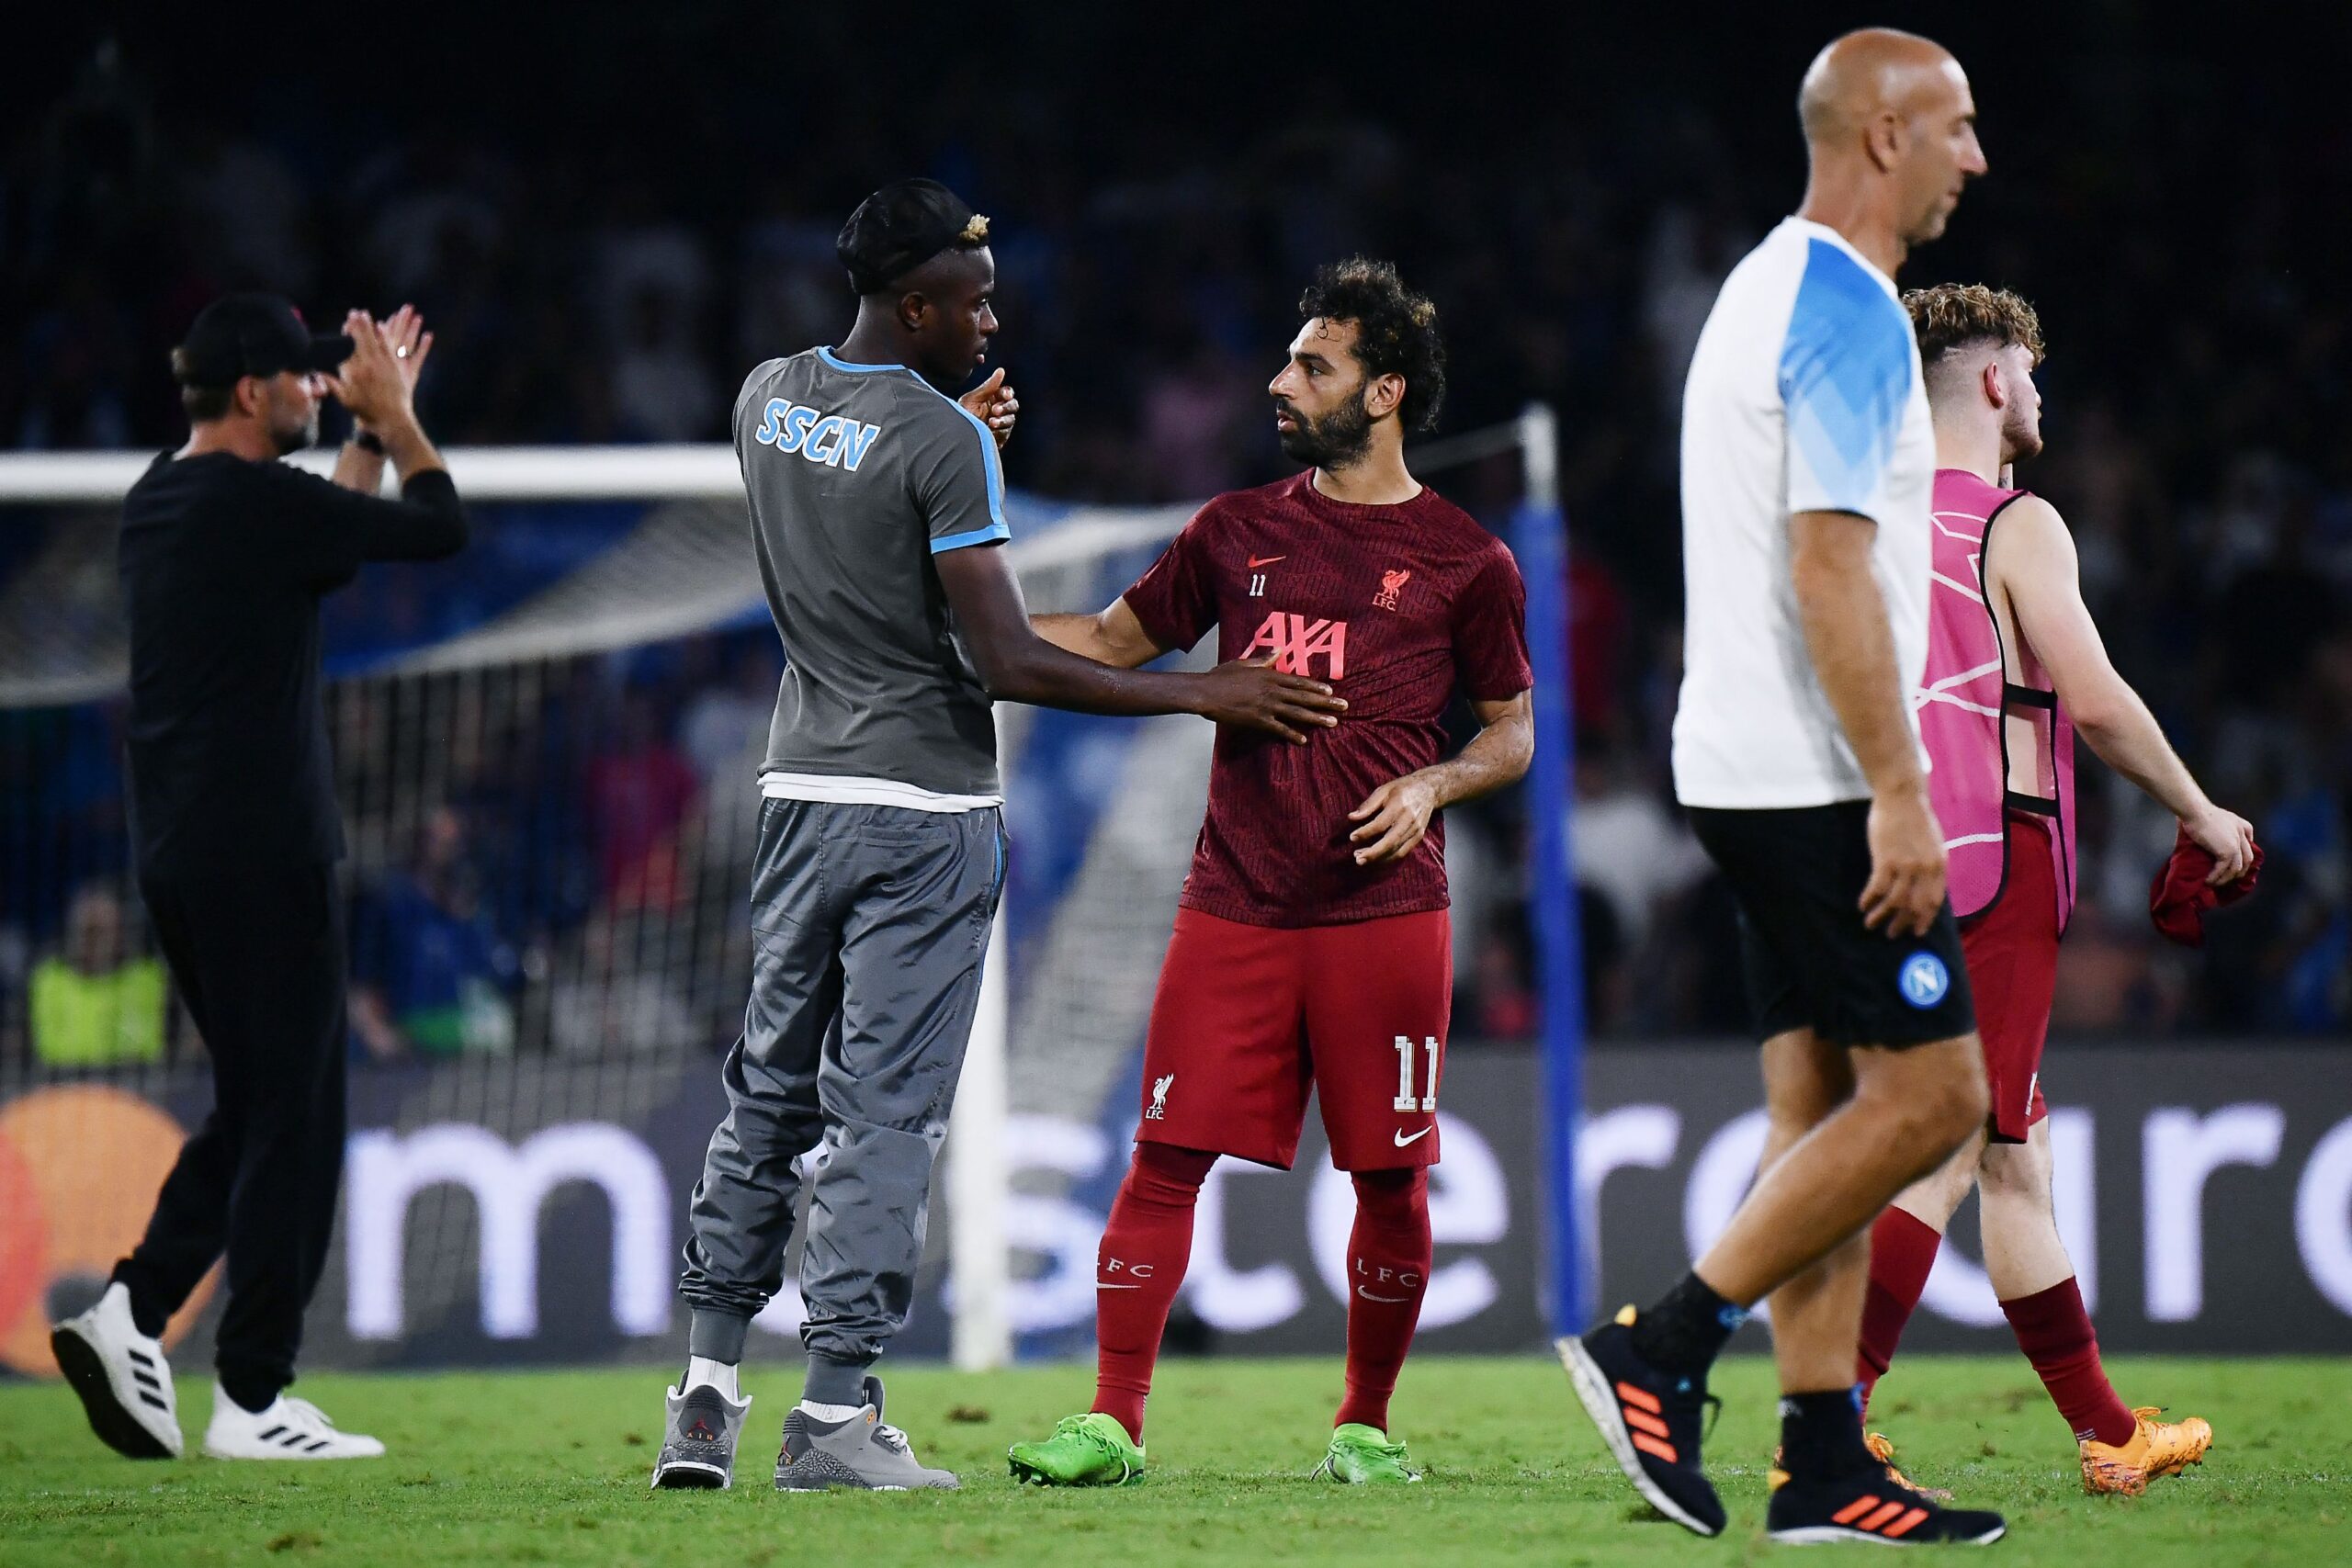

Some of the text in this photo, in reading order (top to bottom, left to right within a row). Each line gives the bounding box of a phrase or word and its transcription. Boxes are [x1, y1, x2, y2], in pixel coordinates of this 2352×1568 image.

[755, 397, 881, 472] SSCN
[1249, 574, 1266, 596] 11
[1238, 611, 1347, 681] AXA
[1394, 1035, 1439, 1113] 11
[1097, 1251, 1154, 1278] FC
[1355, 1257, 1419, 1287] LFC
[686, 1432, 713, 1441] AIR
